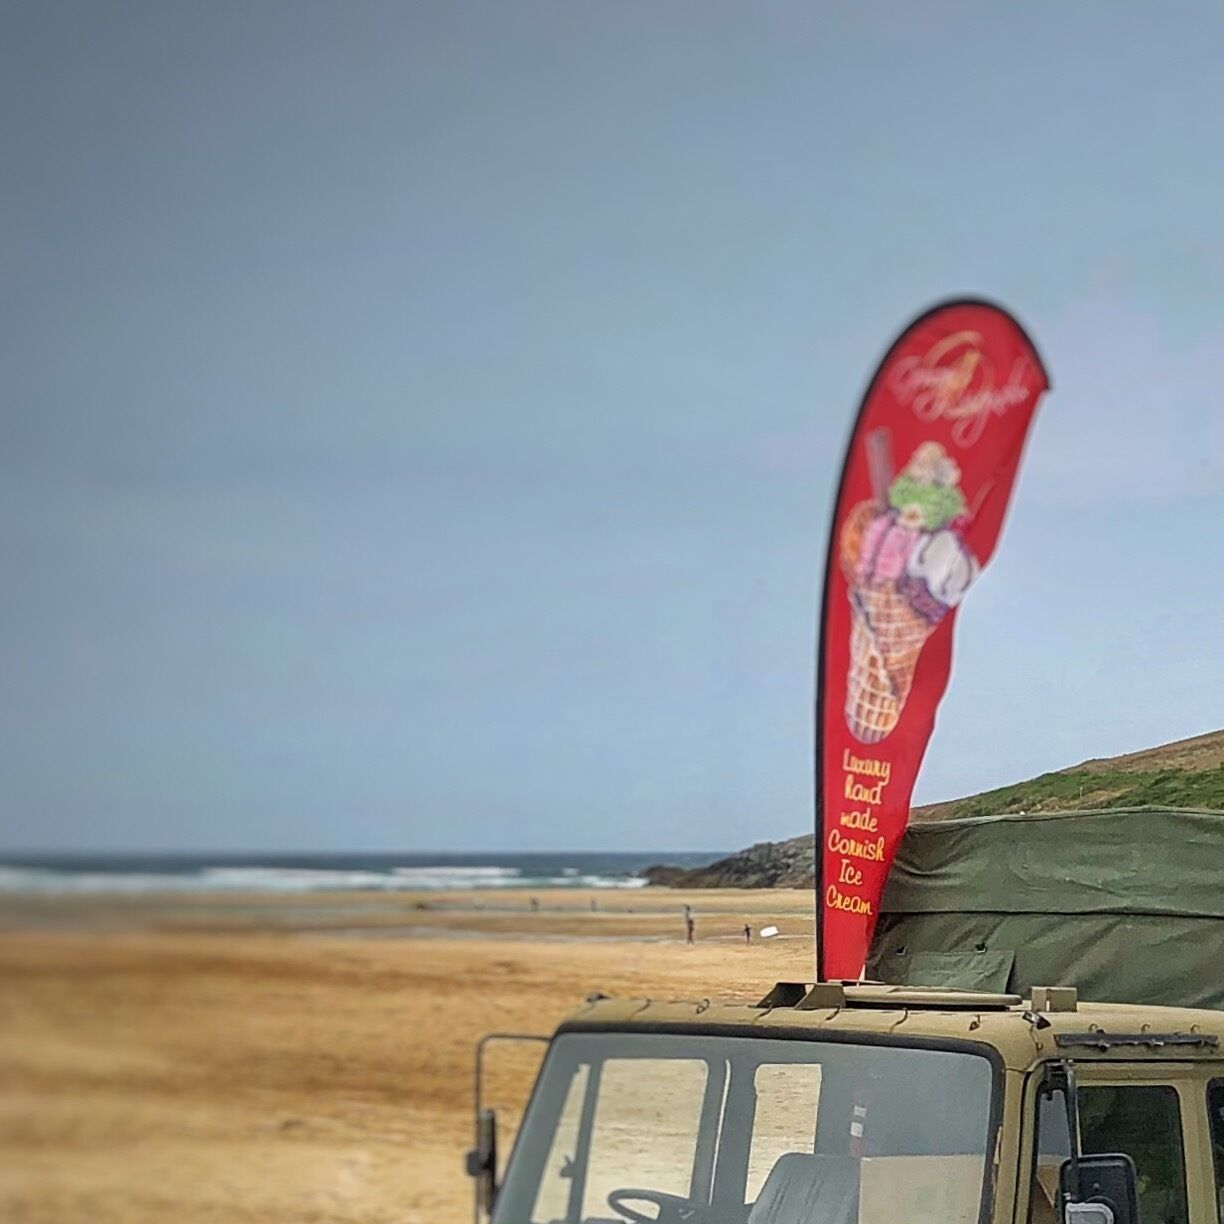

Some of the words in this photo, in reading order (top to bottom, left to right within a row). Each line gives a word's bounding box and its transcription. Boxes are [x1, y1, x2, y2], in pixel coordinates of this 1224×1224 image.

[842, 748, 891, 786] Luxury
[844, 774, 882, 805] hand
[840, 808, 878, 832] made
[828, 829, 885, 861] Cornish
[838, 859, 862, 885] Ice
[826, 885, 873, 916] Cream
